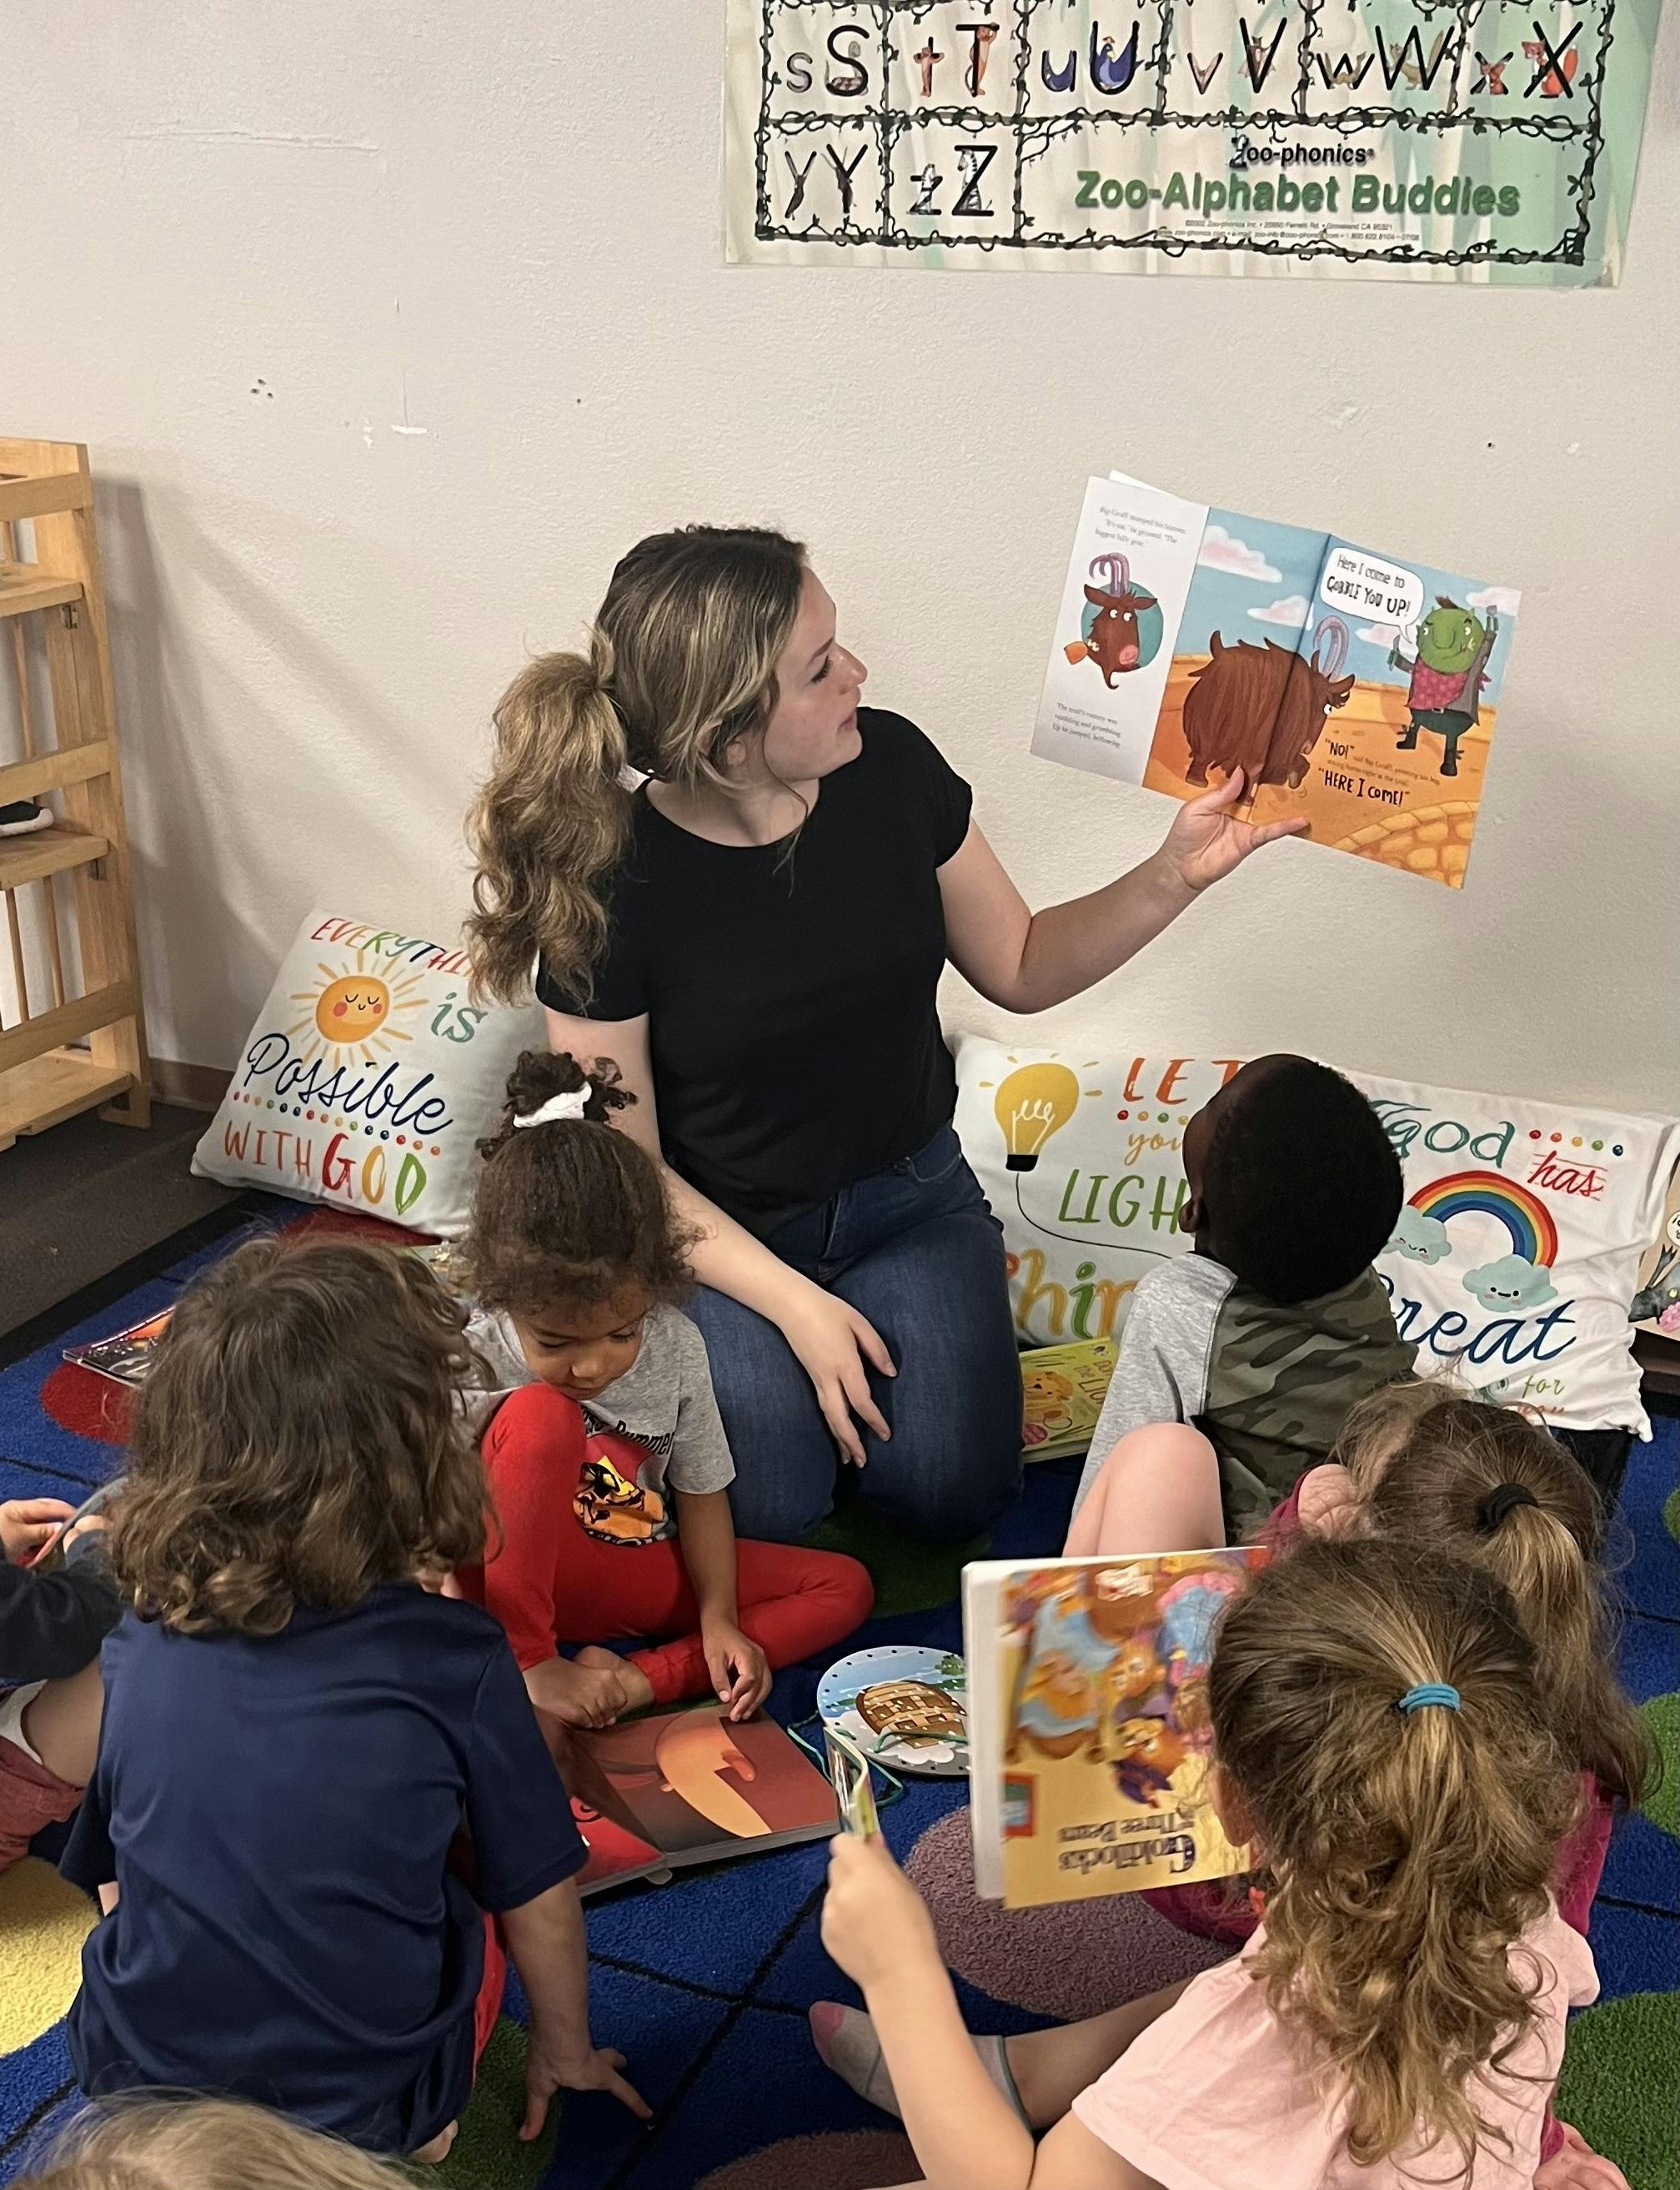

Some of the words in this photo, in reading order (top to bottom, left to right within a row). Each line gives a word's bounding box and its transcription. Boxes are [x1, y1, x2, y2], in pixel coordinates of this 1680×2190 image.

[1075, 171, 1341, 218] Zoo-Alphabet
[1352, 174, 1520, 216] Buddies
[1336, 554, 1357, 573] Here
[1358, 562, 1365, 575] I
[1365, 568, 1392, 585] come
[1394, 575, 1406, 589] to
[1387, 598, 1412, 617] UP!
[1357, 777, 1365, 797] I
[311, 917, 474, 977] EVERYTHI
[430, 992, 488, 1042] is
[246, 1032, 454, 1136] Possible
[224, 1120, 312, 1178] WITH
[322, 1133, 427, 1215] GOD
[1527, 1150, 1605, 1198] has
[1058, 1168, 1189, 1235] LIGH
[1379, 1273, 1577, 1364] reat
[1522, 1374, 1566, 1399] for
